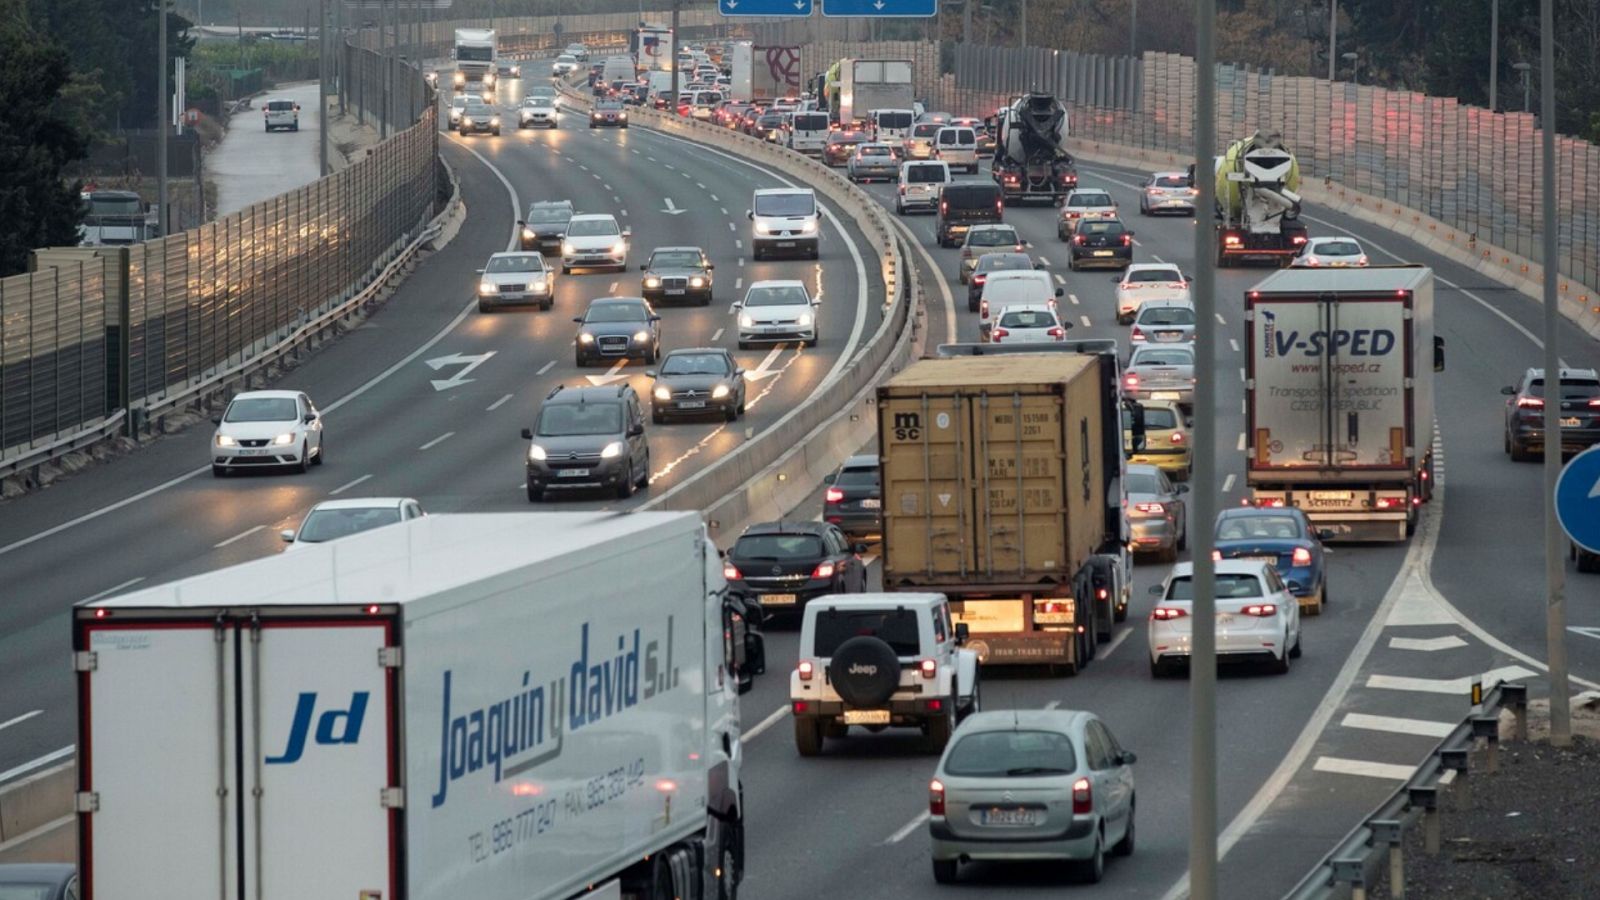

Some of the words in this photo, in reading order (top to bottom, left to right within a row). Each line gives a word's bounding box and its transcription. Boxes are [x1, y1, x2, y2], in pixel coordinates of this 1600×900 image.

[1275, 329, 1395, 357] V-SPED
[1292, 363, 1381, 375] wwwvsped.cz
[569, 622, 640, 731] david
[849, 663, 877, 676] Jeep
